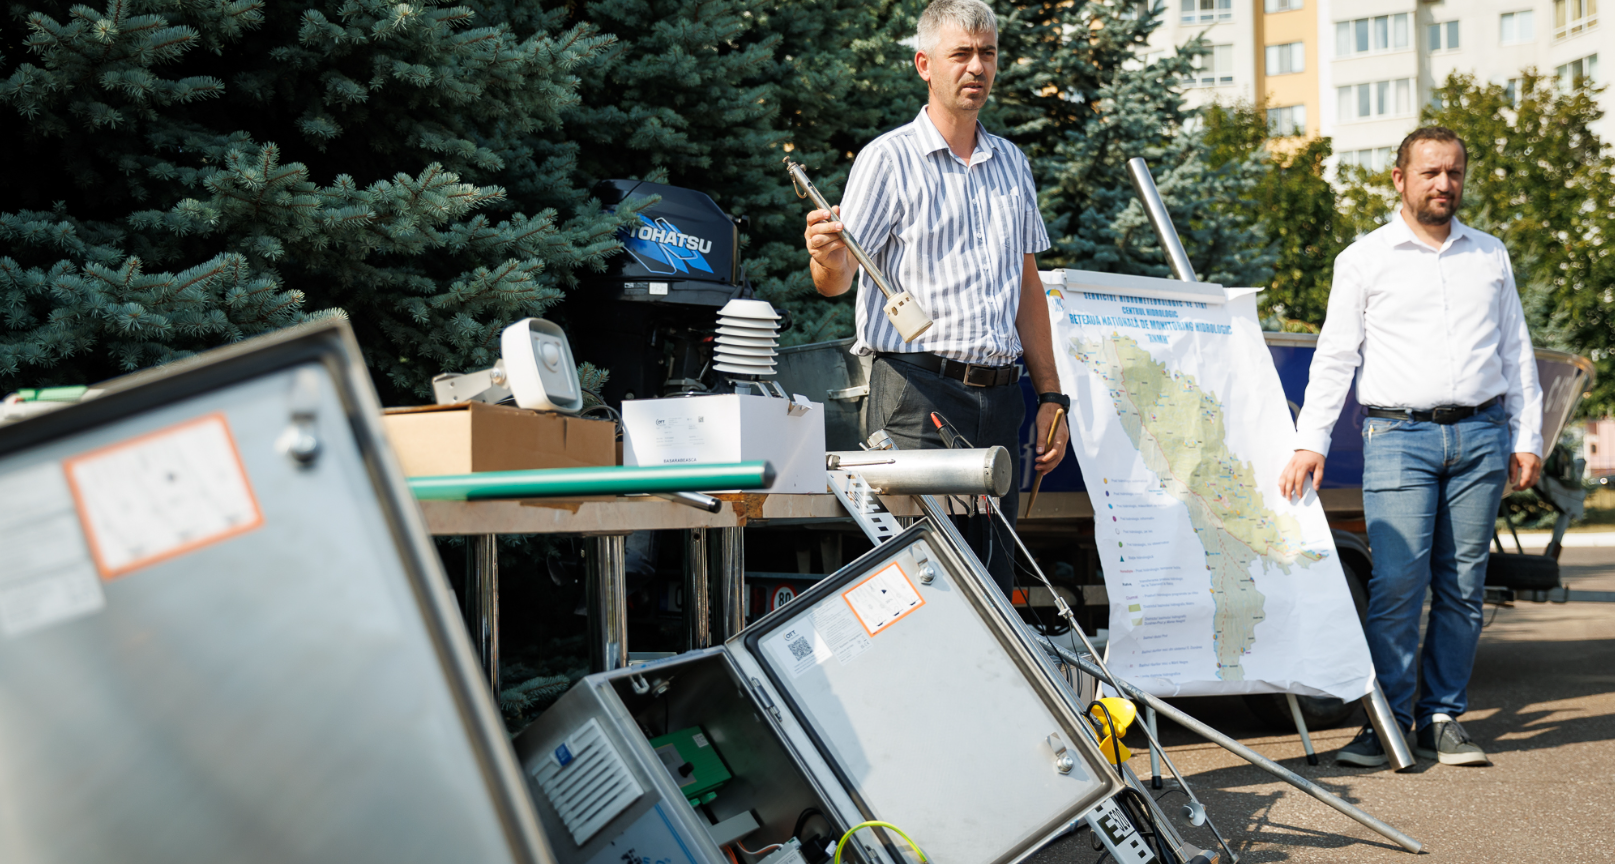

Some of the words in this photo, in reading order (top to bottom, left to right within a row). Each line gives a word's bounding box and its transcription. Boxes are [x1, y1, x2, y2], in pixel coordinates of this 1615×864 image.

[630, 226, 712, 254] TOHATSU
[1083, 292, 1117, 302] SERVICIUL
[1122, 306, 1146, 316] CENTRUL
[1146, 308, 1178, 318] HIDROLOGIC
[1140, 319, 1149, 329] DE
[1150, 320, 1194, 331] MONITORING
[1194, 322, 1233, 335] HIDROLOGIC
[778, 592, 791, 606] 80
